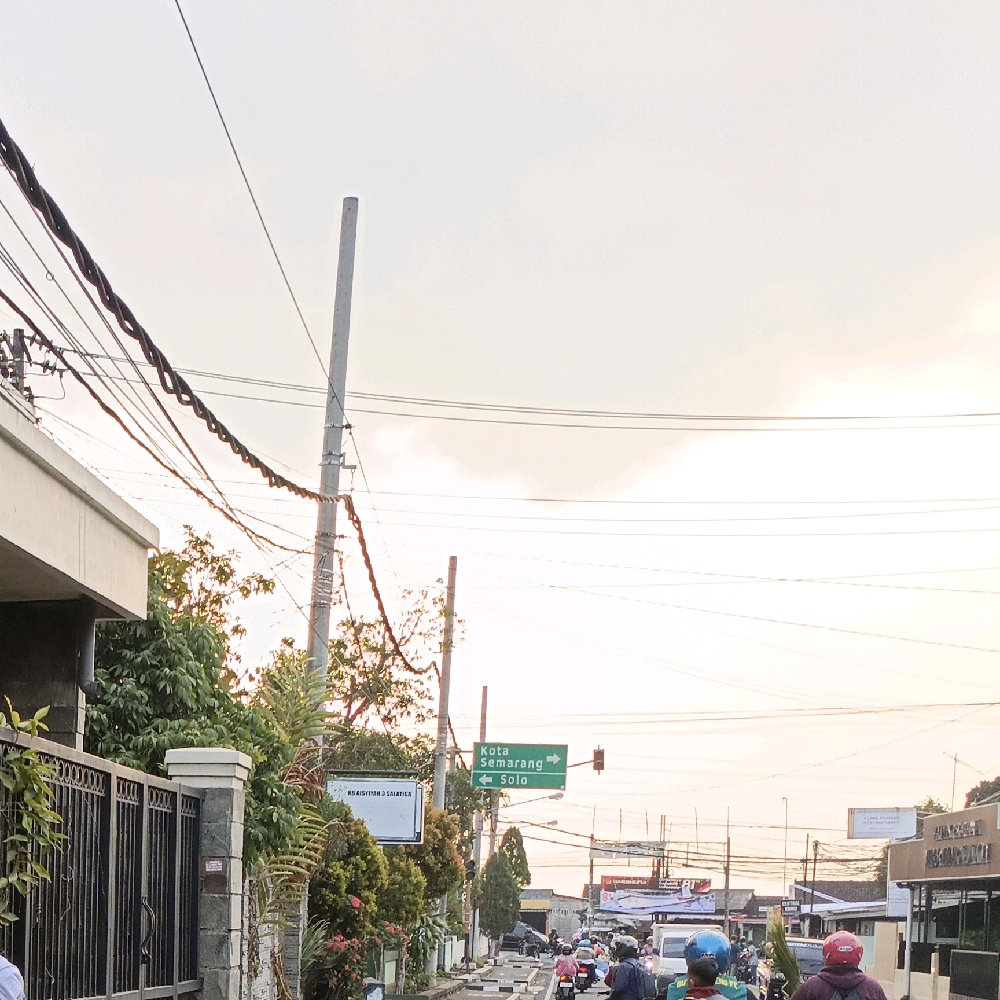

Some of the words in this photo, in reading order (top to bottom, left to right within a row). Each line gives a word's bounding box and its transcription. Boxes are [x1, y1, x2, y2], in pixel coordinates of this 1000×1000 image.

[480, 745, 509, 756] Kota
[480, 757, 543, 771] Semarang
[500, 774, 528, 785] Solo
